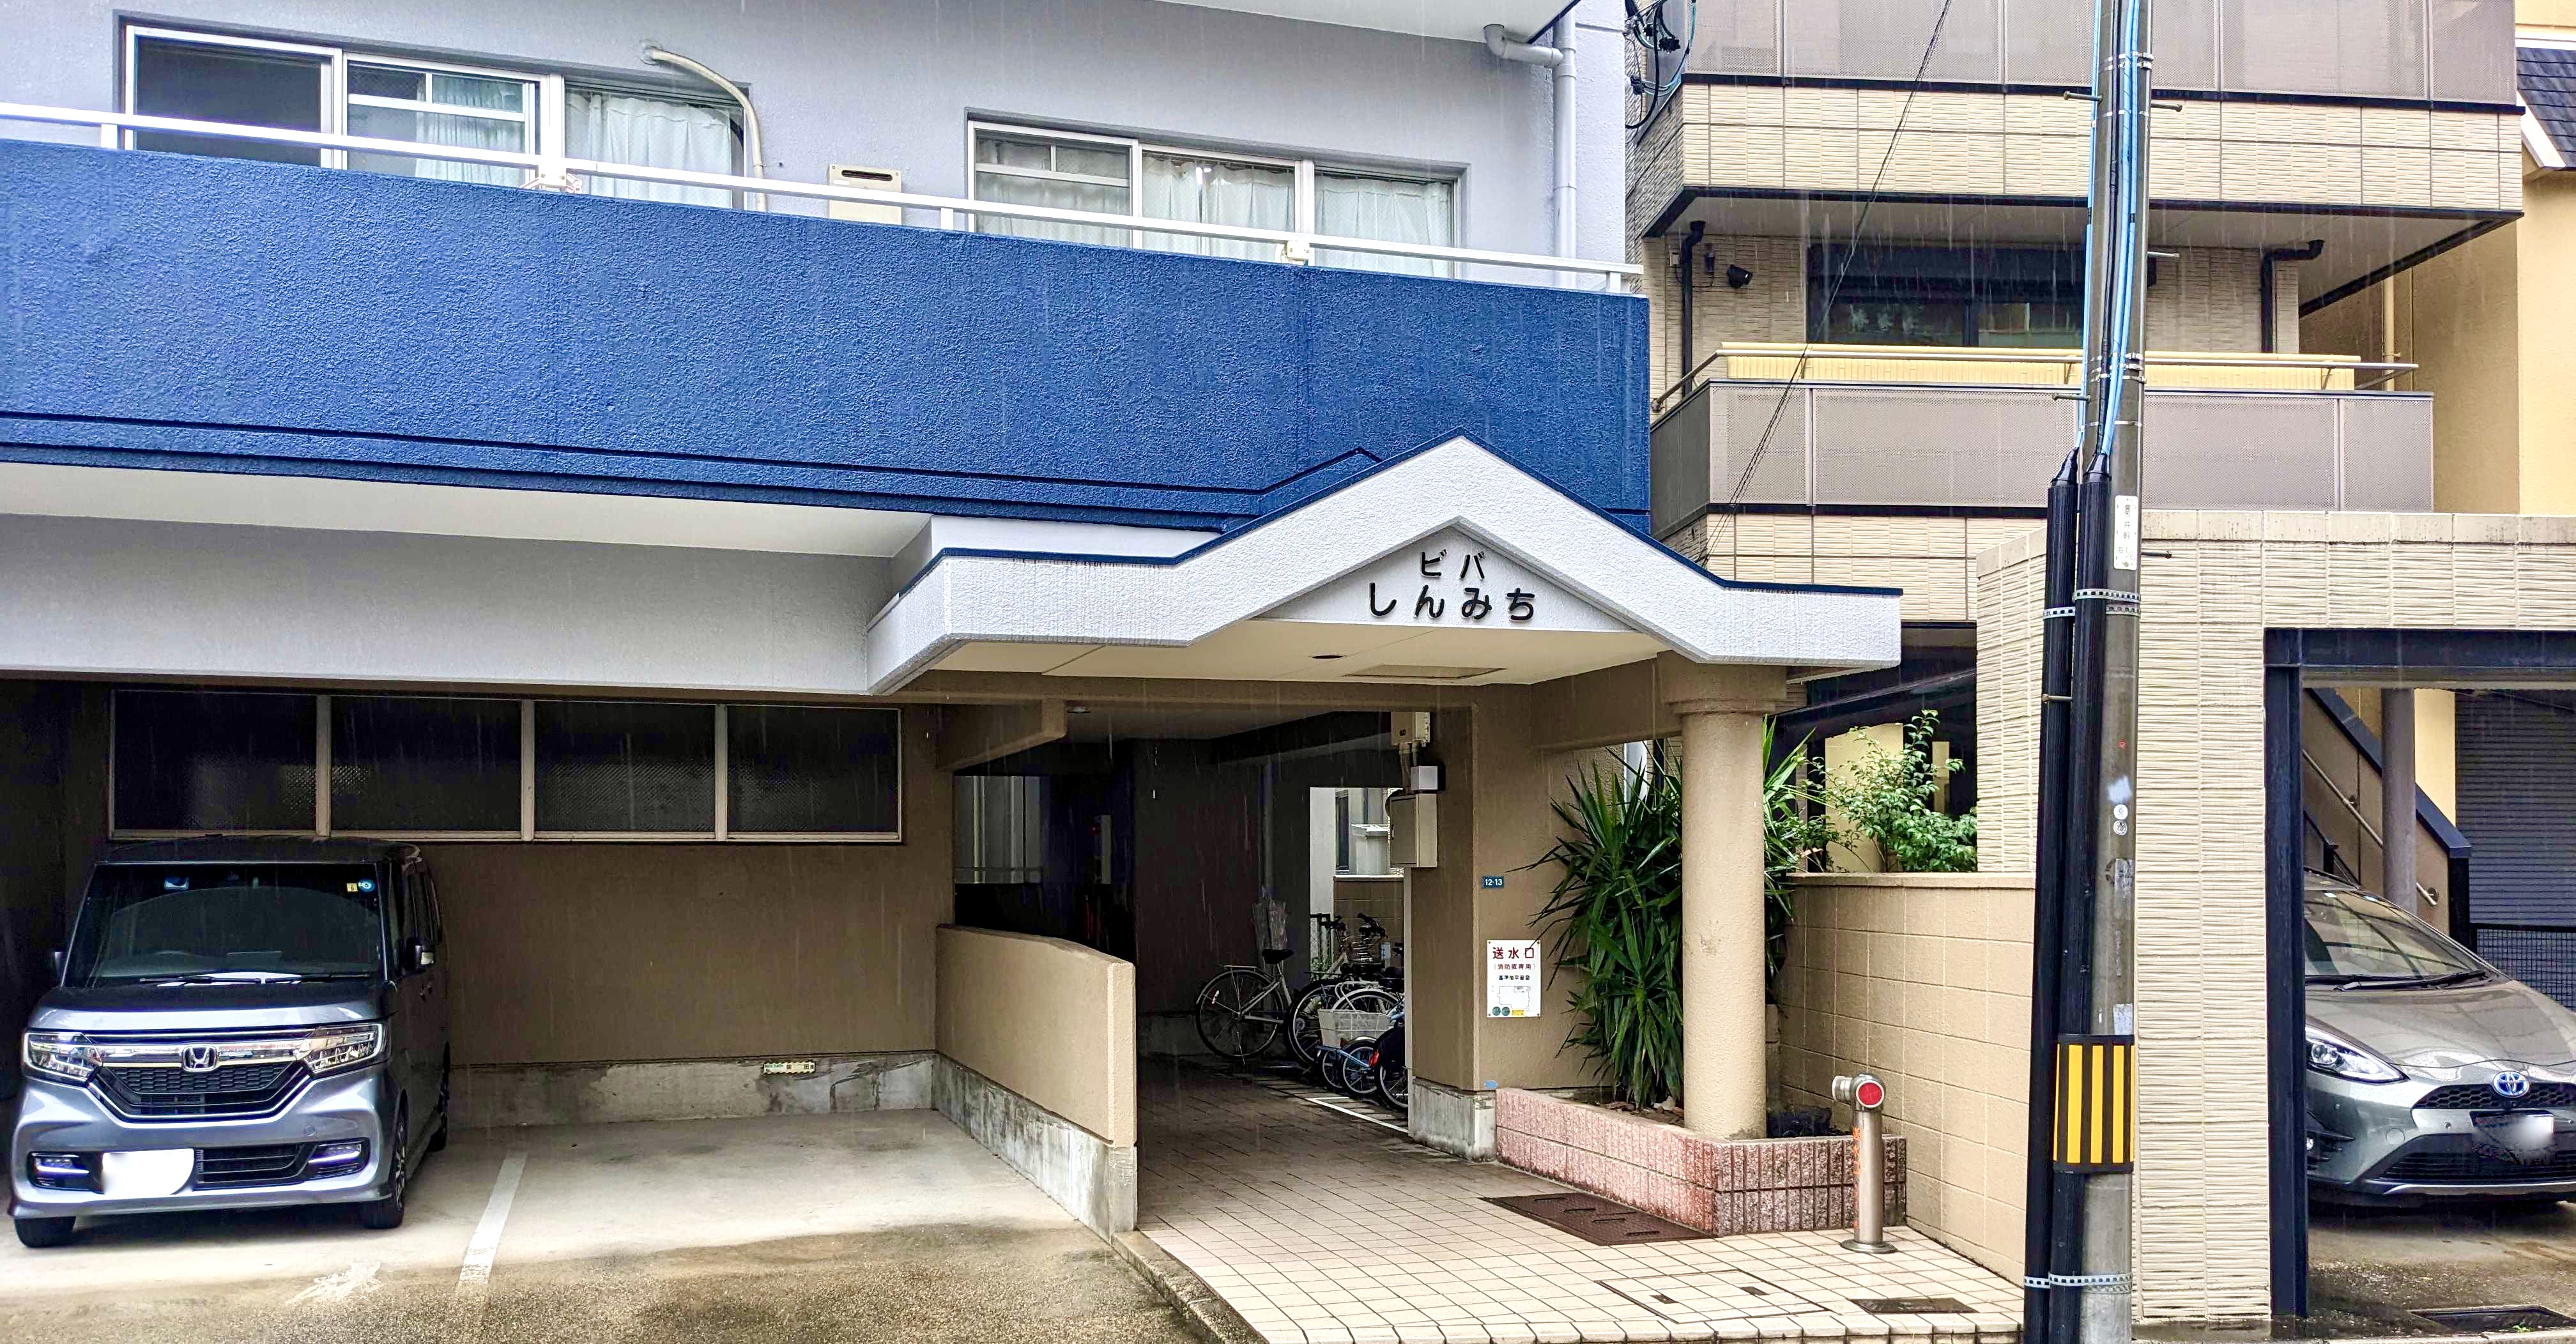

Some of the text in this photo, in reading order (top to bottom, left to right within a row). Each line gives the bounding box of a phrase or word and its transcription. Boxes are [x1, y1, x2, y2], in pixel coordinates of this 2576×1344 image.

[1421, 549, 1485, 579] ビバ
[1369, 582, 1535, 620] しんみち
[1492, 947, 1535, 959] 送水口
